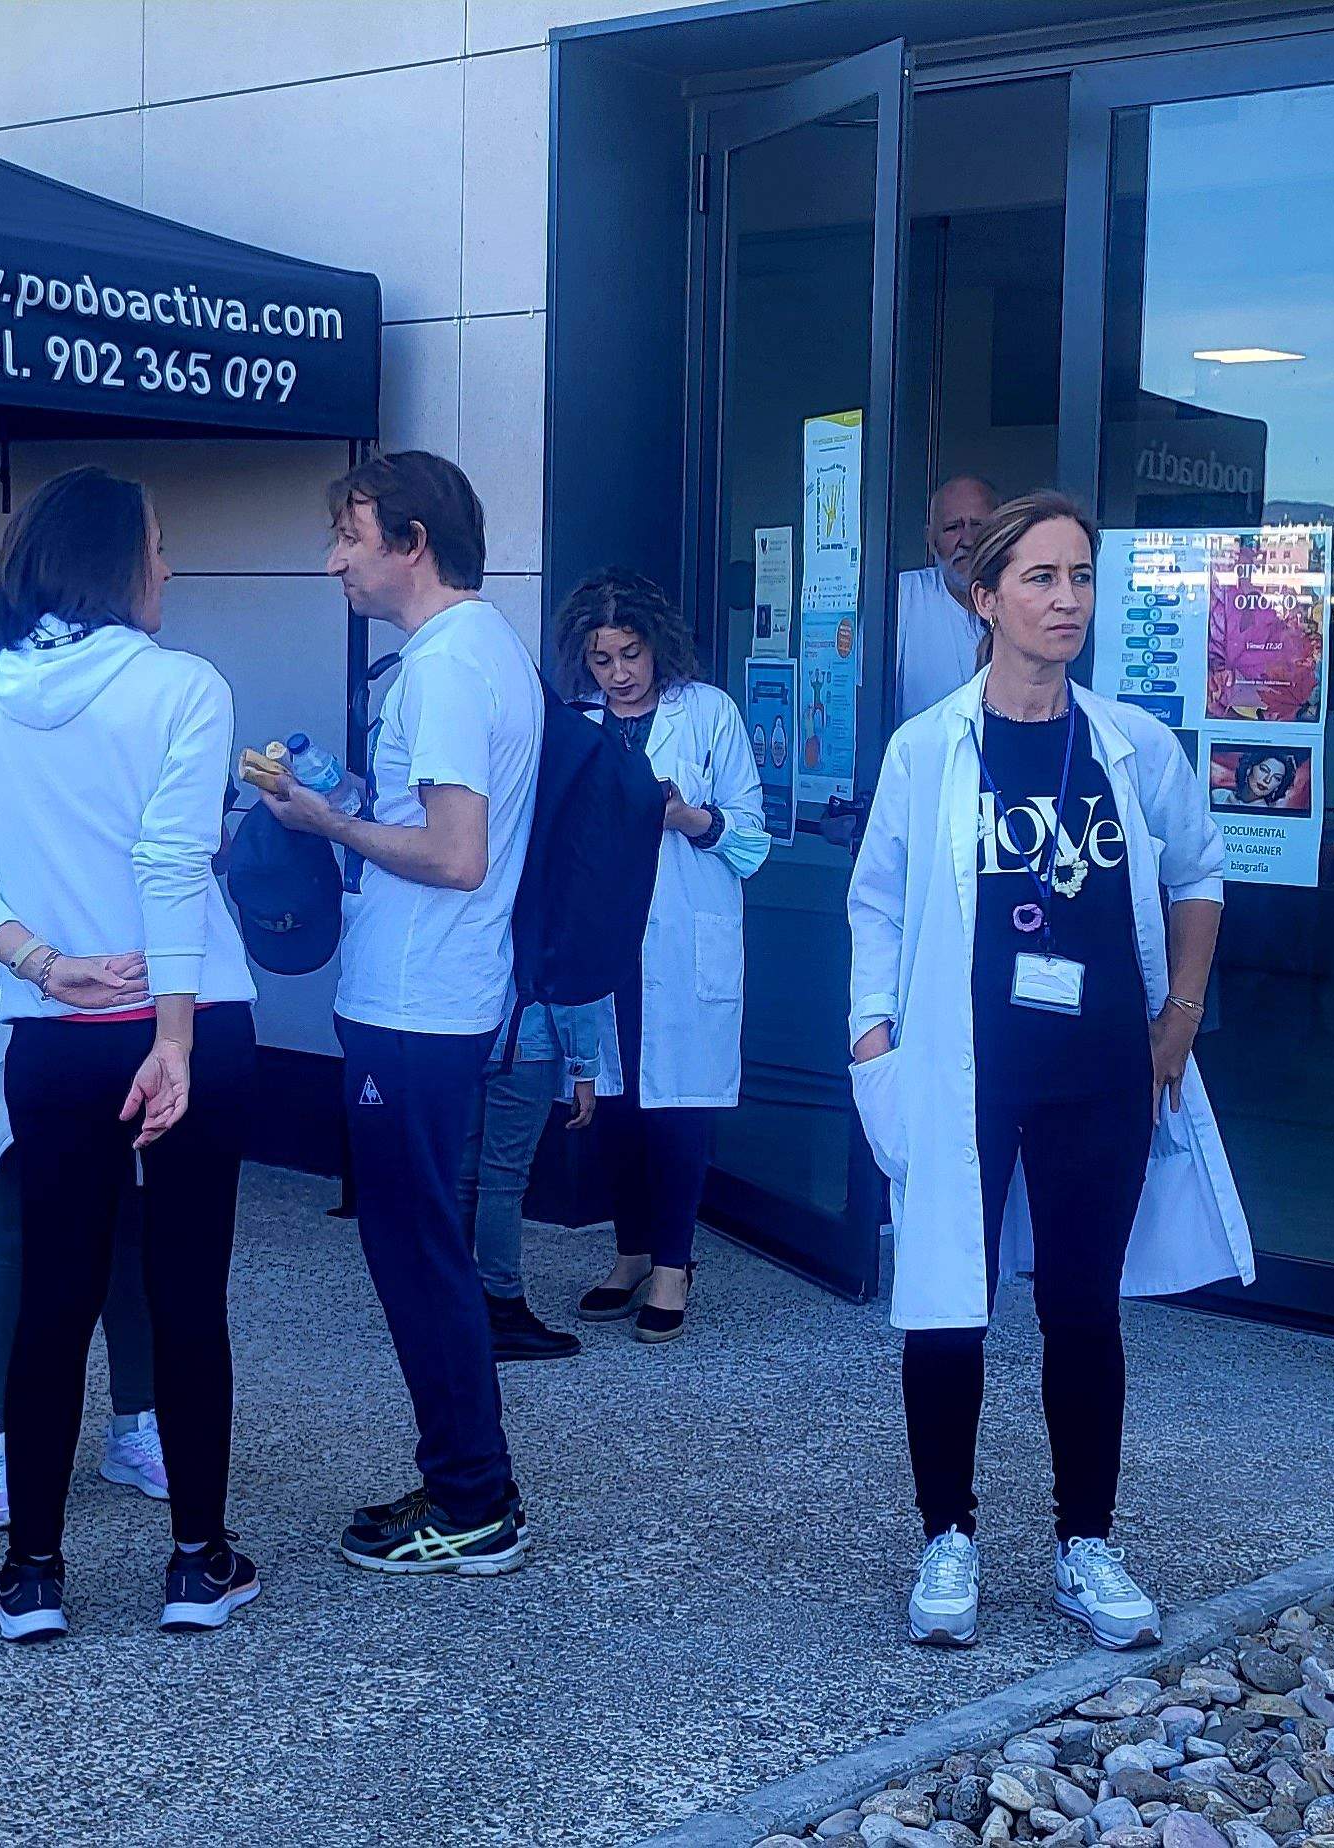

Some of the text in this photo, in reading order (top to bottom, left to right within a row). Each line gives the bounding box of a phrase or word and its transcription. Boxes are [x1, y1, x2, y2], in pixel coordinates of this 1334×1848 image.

[46, 334, 126, 388] 902
[134, 346, 213, 395] 365
[223, 355, 298, 404] 099
[1223, 825, 1286, 838] DOCUMENTAL
[1225, 843, 1282, 856] AVA GARNER
